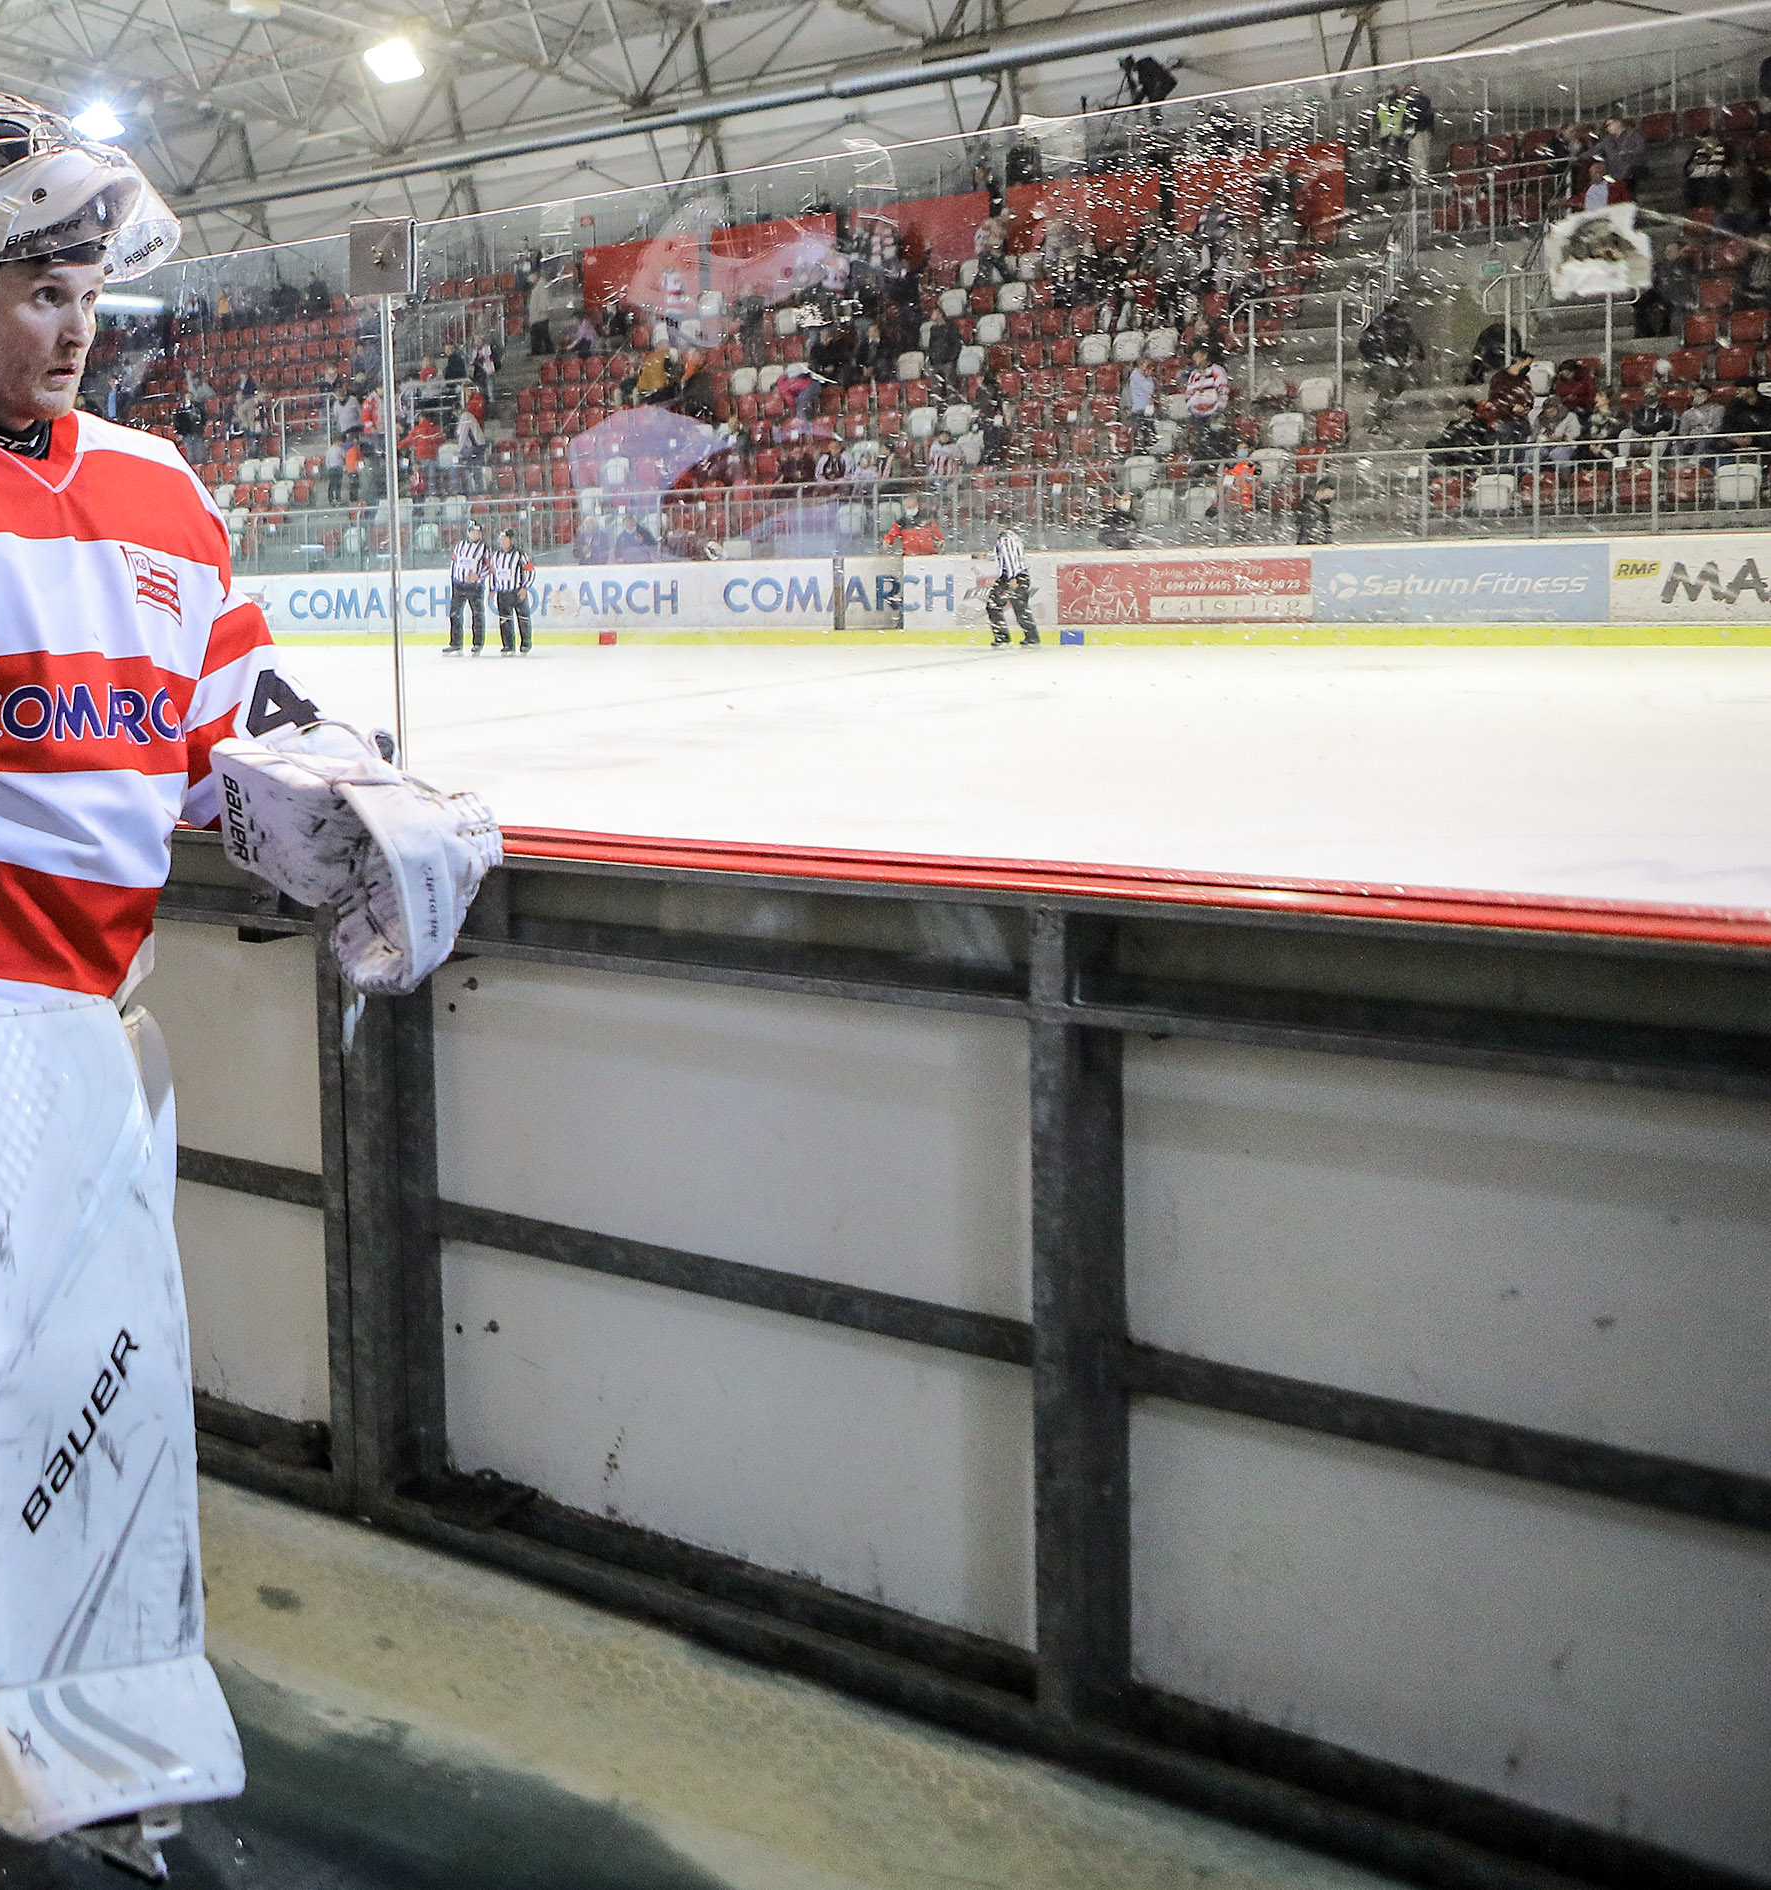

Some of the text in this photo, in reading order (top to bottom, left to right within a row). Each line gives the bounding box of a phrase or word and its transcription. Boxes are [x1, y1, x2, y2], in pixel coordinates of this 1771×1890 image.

[289, 585, 451, 620] COMACH
[723, 573, 955, 613] COMARCH
[1617, 557, 1771, 605] RMF MA
[222, 773, 250, 863] BAUER
[20, 1326, 140, 1534] BAUER
